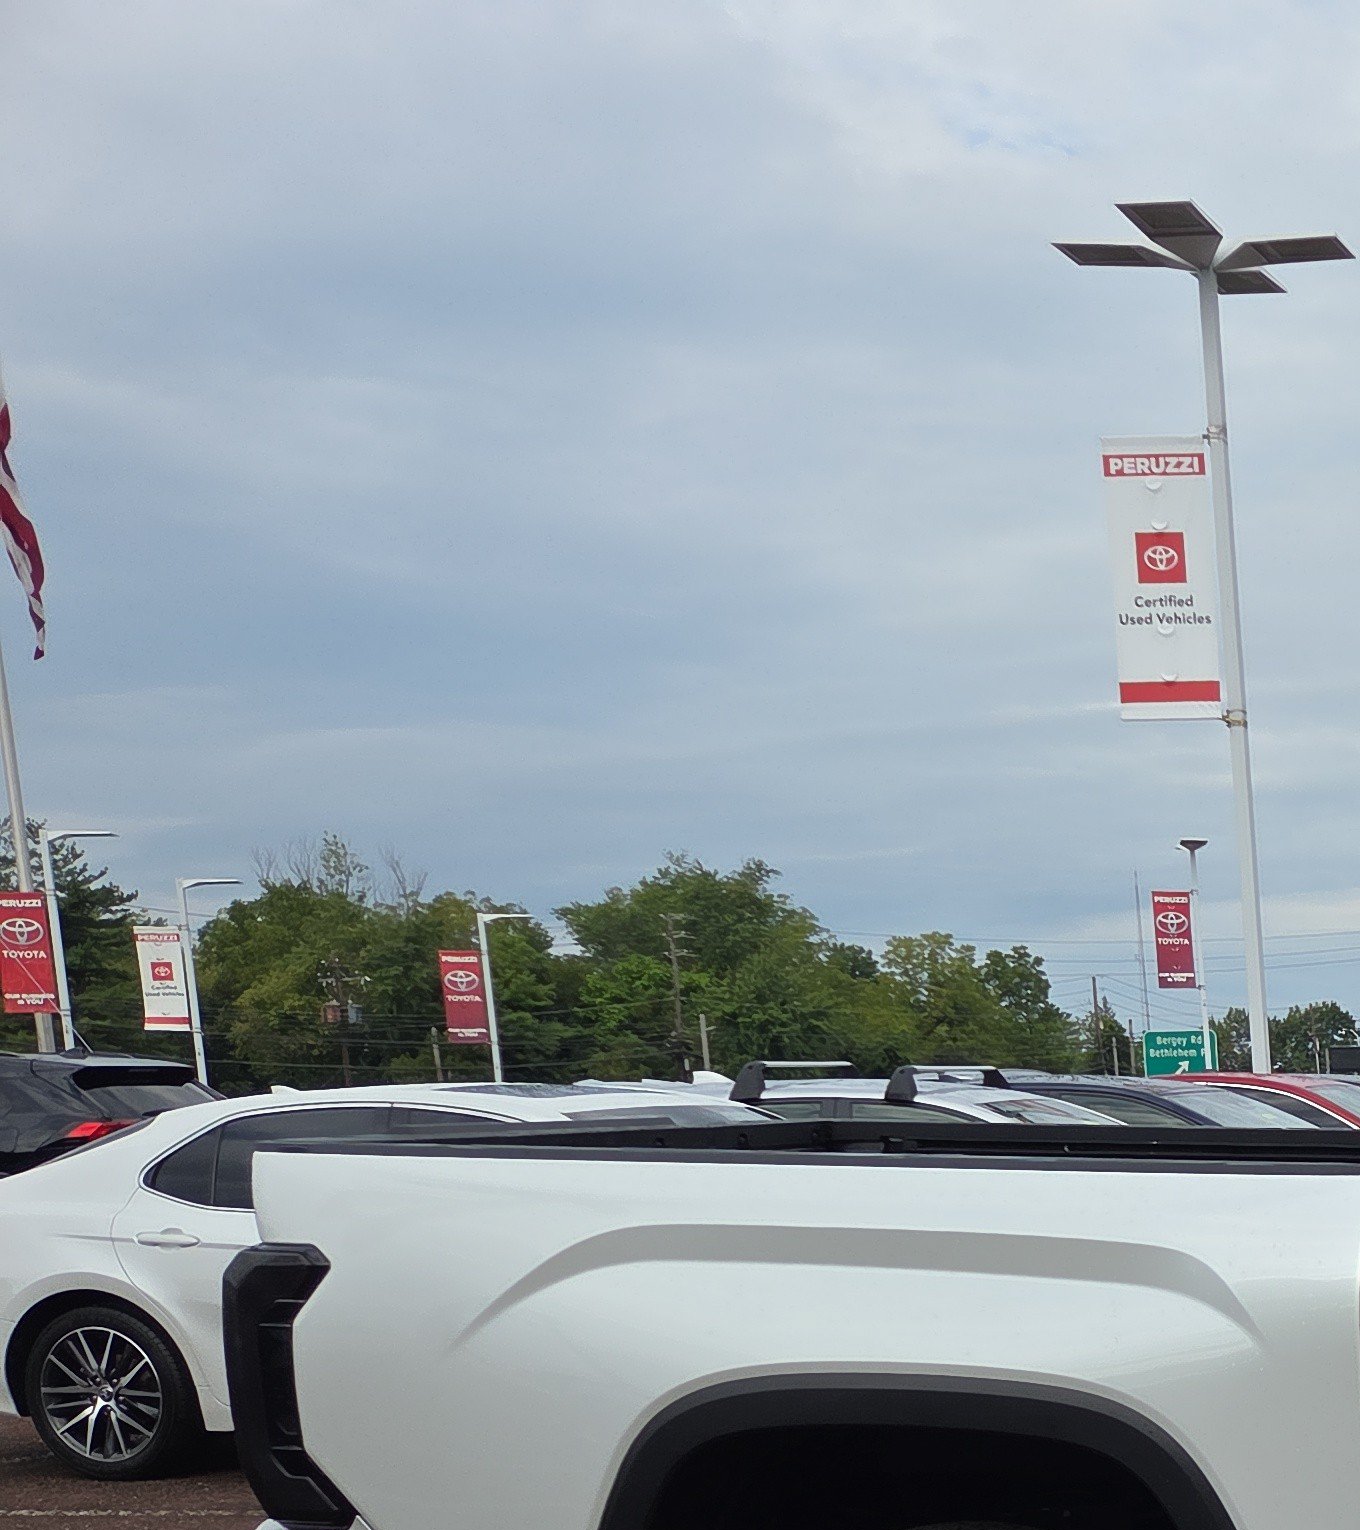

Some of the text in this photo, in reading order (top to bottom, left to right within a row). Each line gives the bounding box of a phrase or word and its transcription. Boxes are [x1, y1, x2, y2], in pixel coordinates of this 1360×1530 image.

[1108, 456, 1200, 475] PERUZZI
[1134, 594, 1194, 608] Certified
[1118, 611, 1212, 626] Used Vehicles
[2, 950, 47, 959] TOYOTA
[1156, 1035, 1202, 1047] Bergey Rd
[1149, 1048, 1198, 1058] Bethlehem
